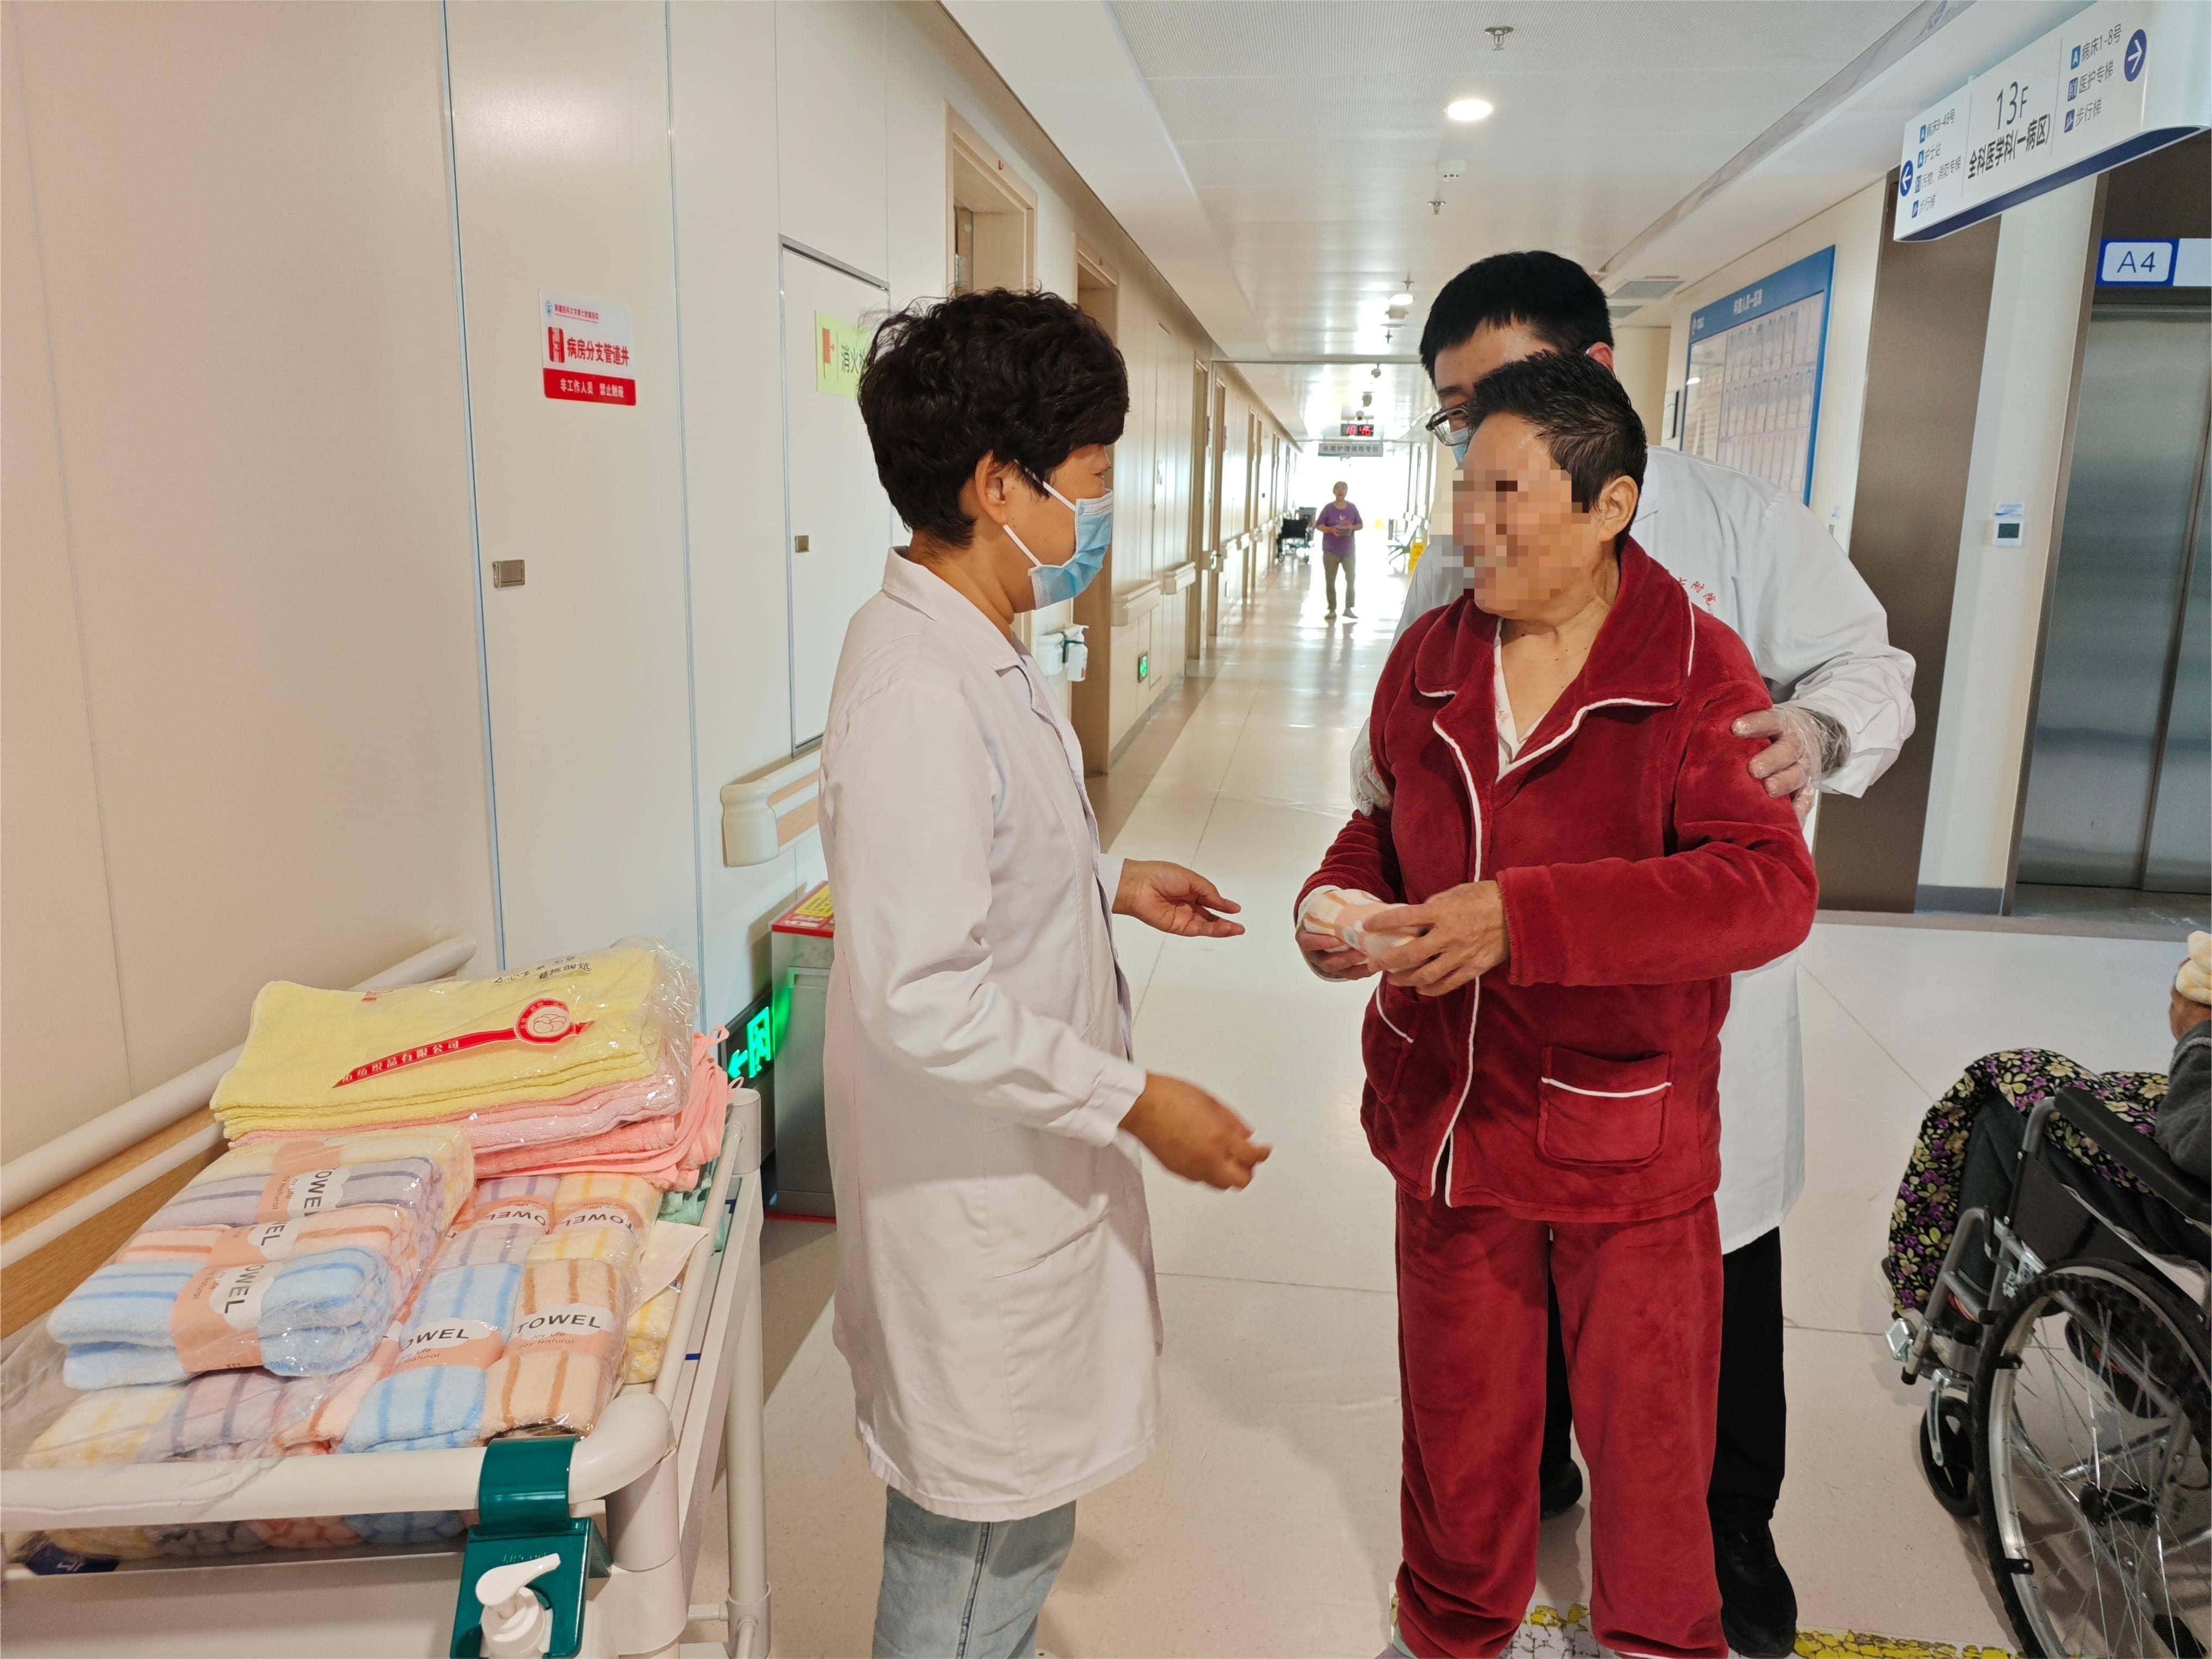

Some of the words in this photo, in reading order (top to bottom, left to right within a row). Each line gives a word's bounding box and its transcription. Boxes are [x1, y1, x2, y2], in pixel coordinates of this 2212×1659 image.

[2082, 23, 2122, 63] 病床1-8号
[2079, 60, 2113, 93] 医护专梯
[1997, 82, 2028, 130] 13F
[2076, 97, 2101, 126] 步行梯
[1919, 194, 1936, 214] 步行梯
[2117, 251, 2155, 273] A4
[567, 337, 629, 366] 病房分支管道井
[560, 379, 593, 395] 非工作人员
[538, 962, 592, 980] 精挑细选
[562, 1214, 633, 1234] TOWEL
[224, 1264, 265, 1314] OWEL
[517, 1314, 601, 1334] TOWEL
[401, 1328, 469, 1352] OWEL
